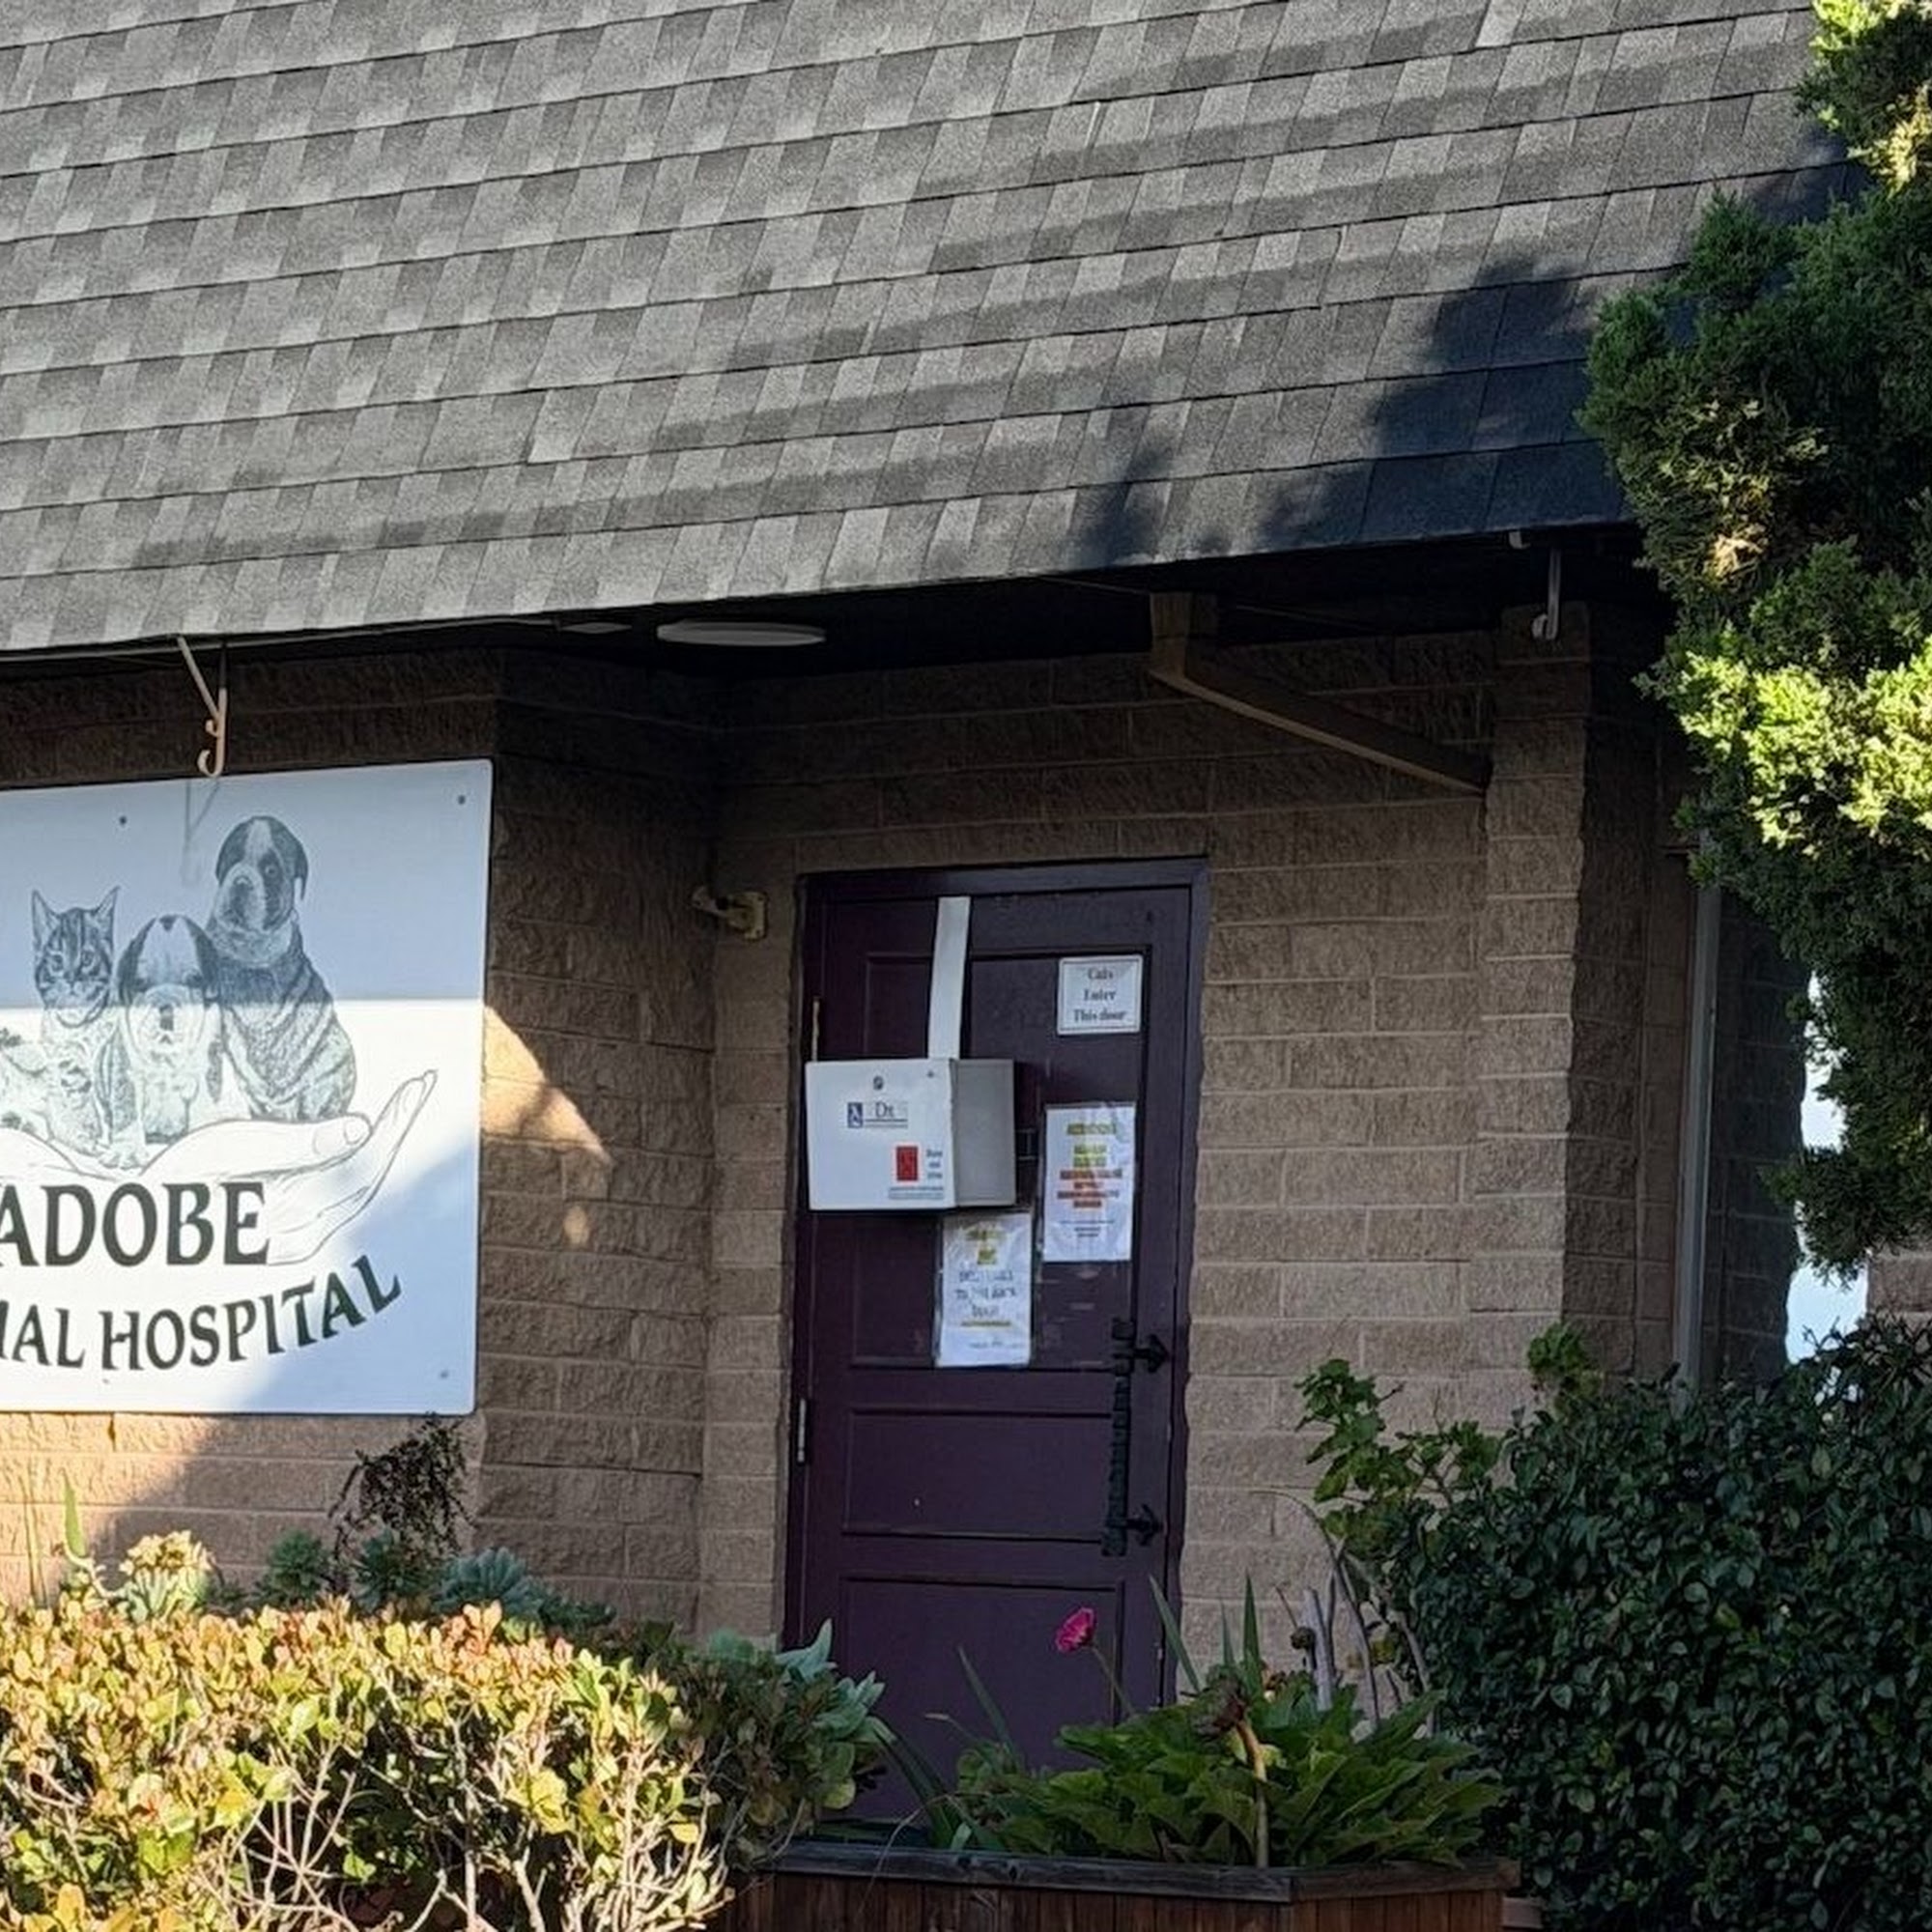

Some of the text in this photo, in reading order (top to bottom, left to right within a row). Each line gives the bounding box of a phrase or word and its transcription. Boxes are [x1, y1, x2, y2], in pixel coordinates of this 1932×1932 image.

[1074, 1007, 1128, 1023] This door
[0, 1182, 270, 1266] ADOBE
[0, 1255, 402, 1371] AL HOSPITAL
